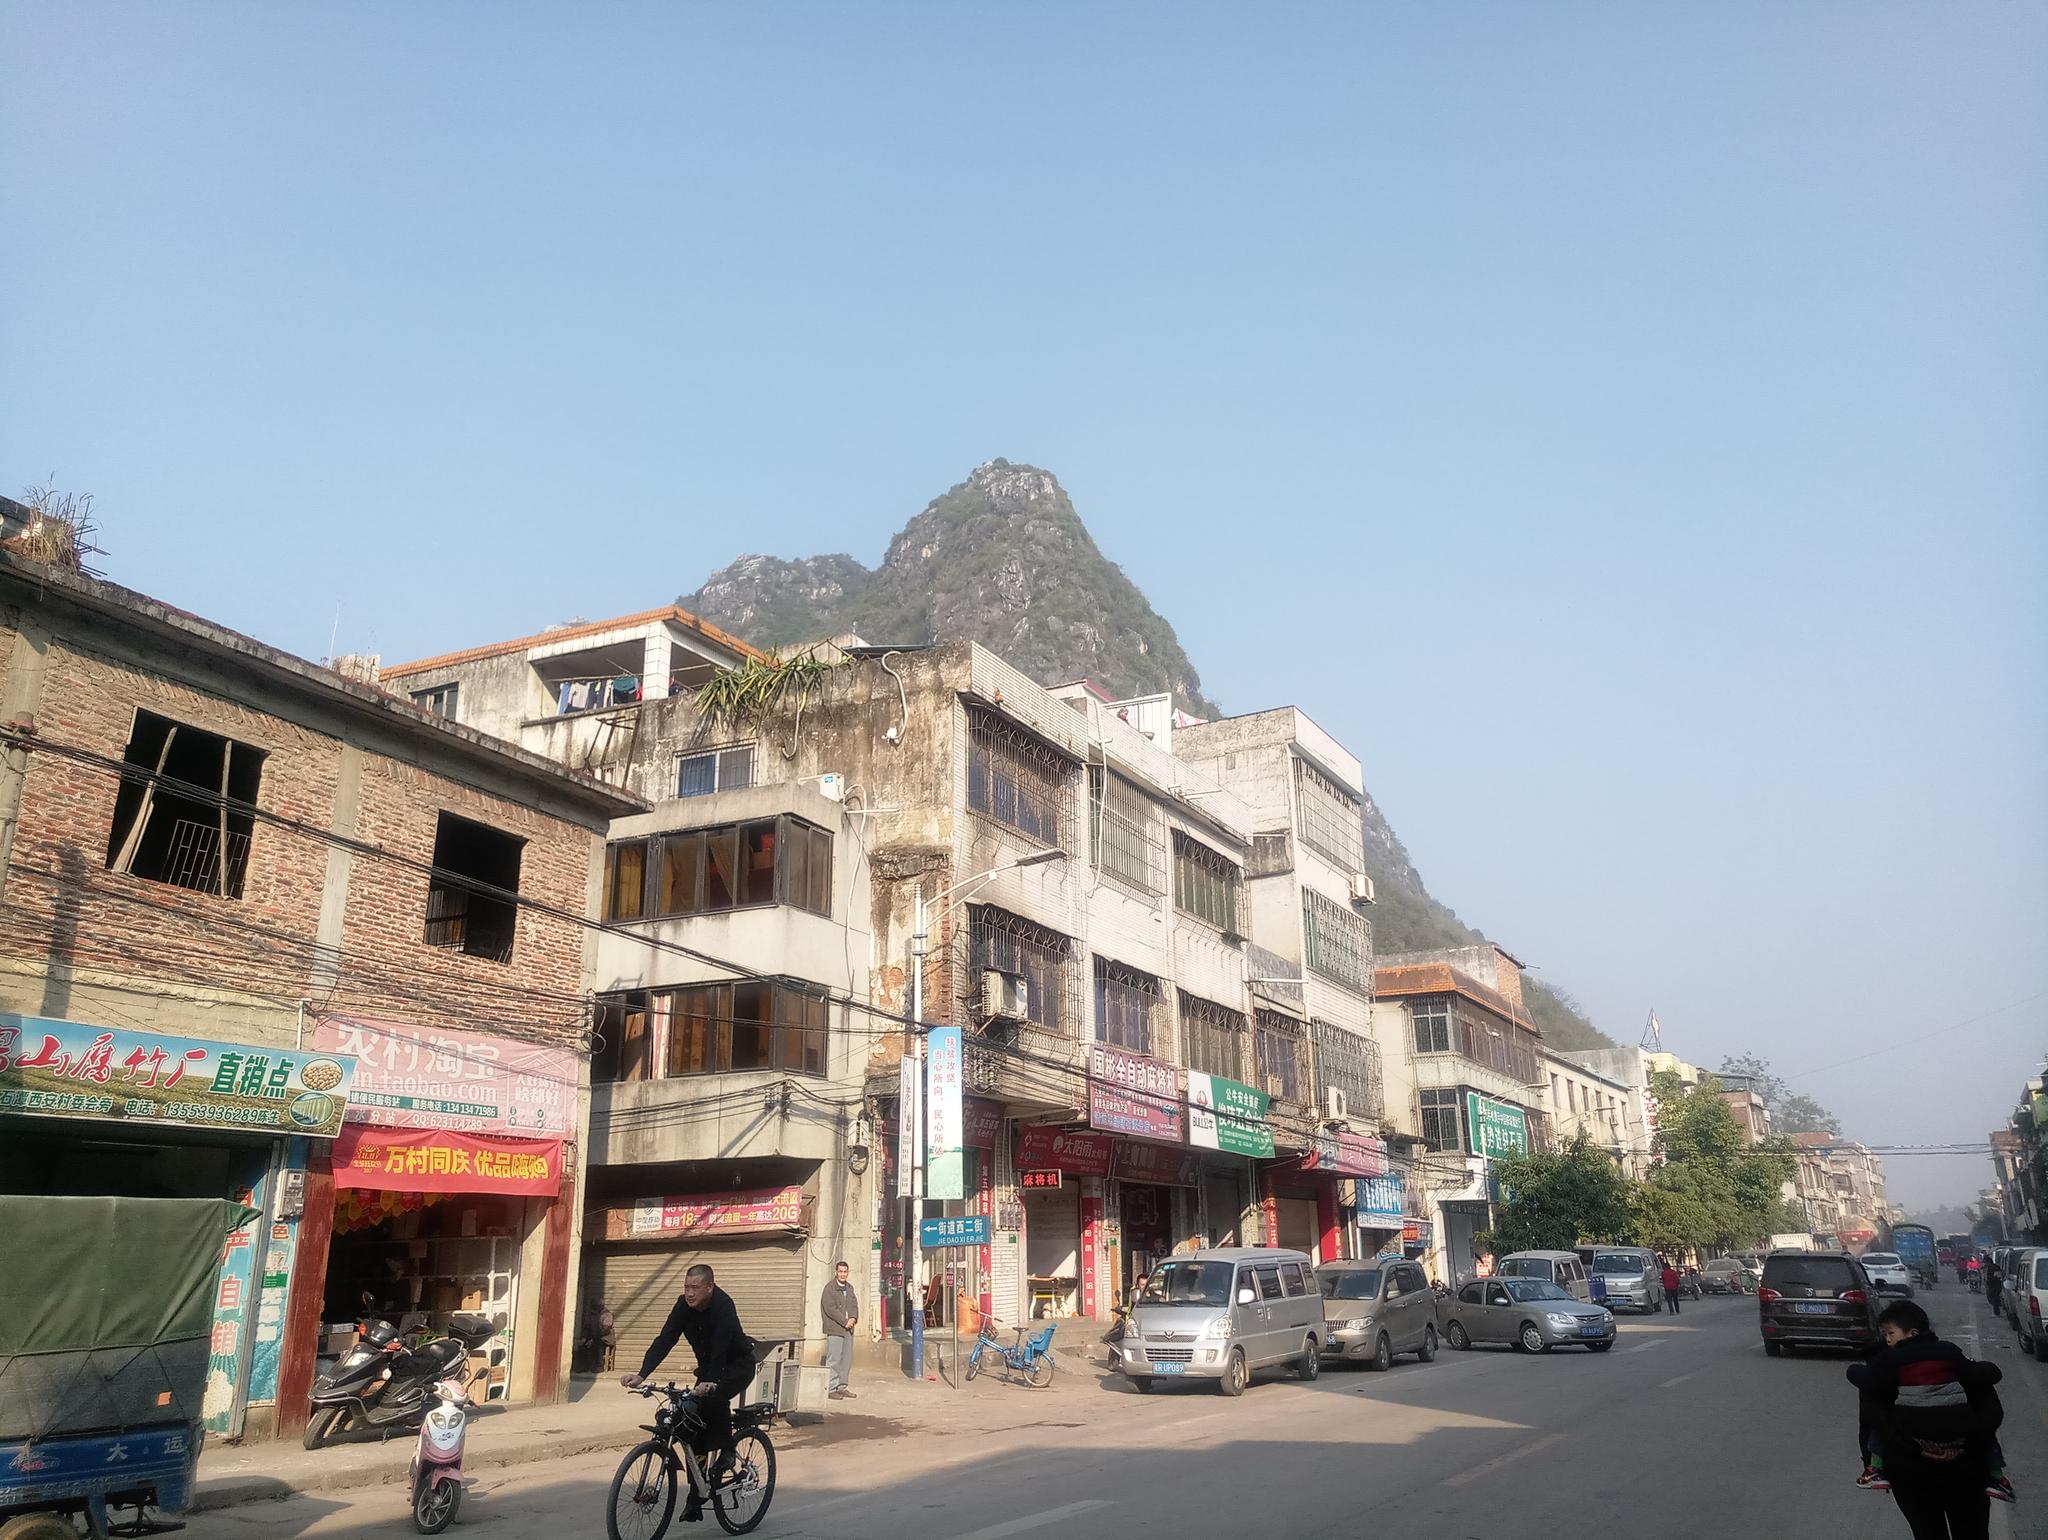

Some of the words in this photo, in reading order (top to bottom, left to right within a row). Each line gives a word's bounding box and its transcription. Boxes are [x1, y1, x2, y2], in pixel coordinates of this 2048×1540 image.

[335, 1024, 500, 1082] 农村淘宝
[209, 1052, 295, 1099] 直销点
[1063, 1139, 1094, 1157] 太阳雨
[384, 1146, 472, 1176] 万村同庆
[473, 1151, 549, 1180] 优品嗨购
[1023, 1173, 1058, 1187] 麻将机
[938, 1219, 983, 1235] 街道西二街
[947, 1236, 959, 1244] DAO
